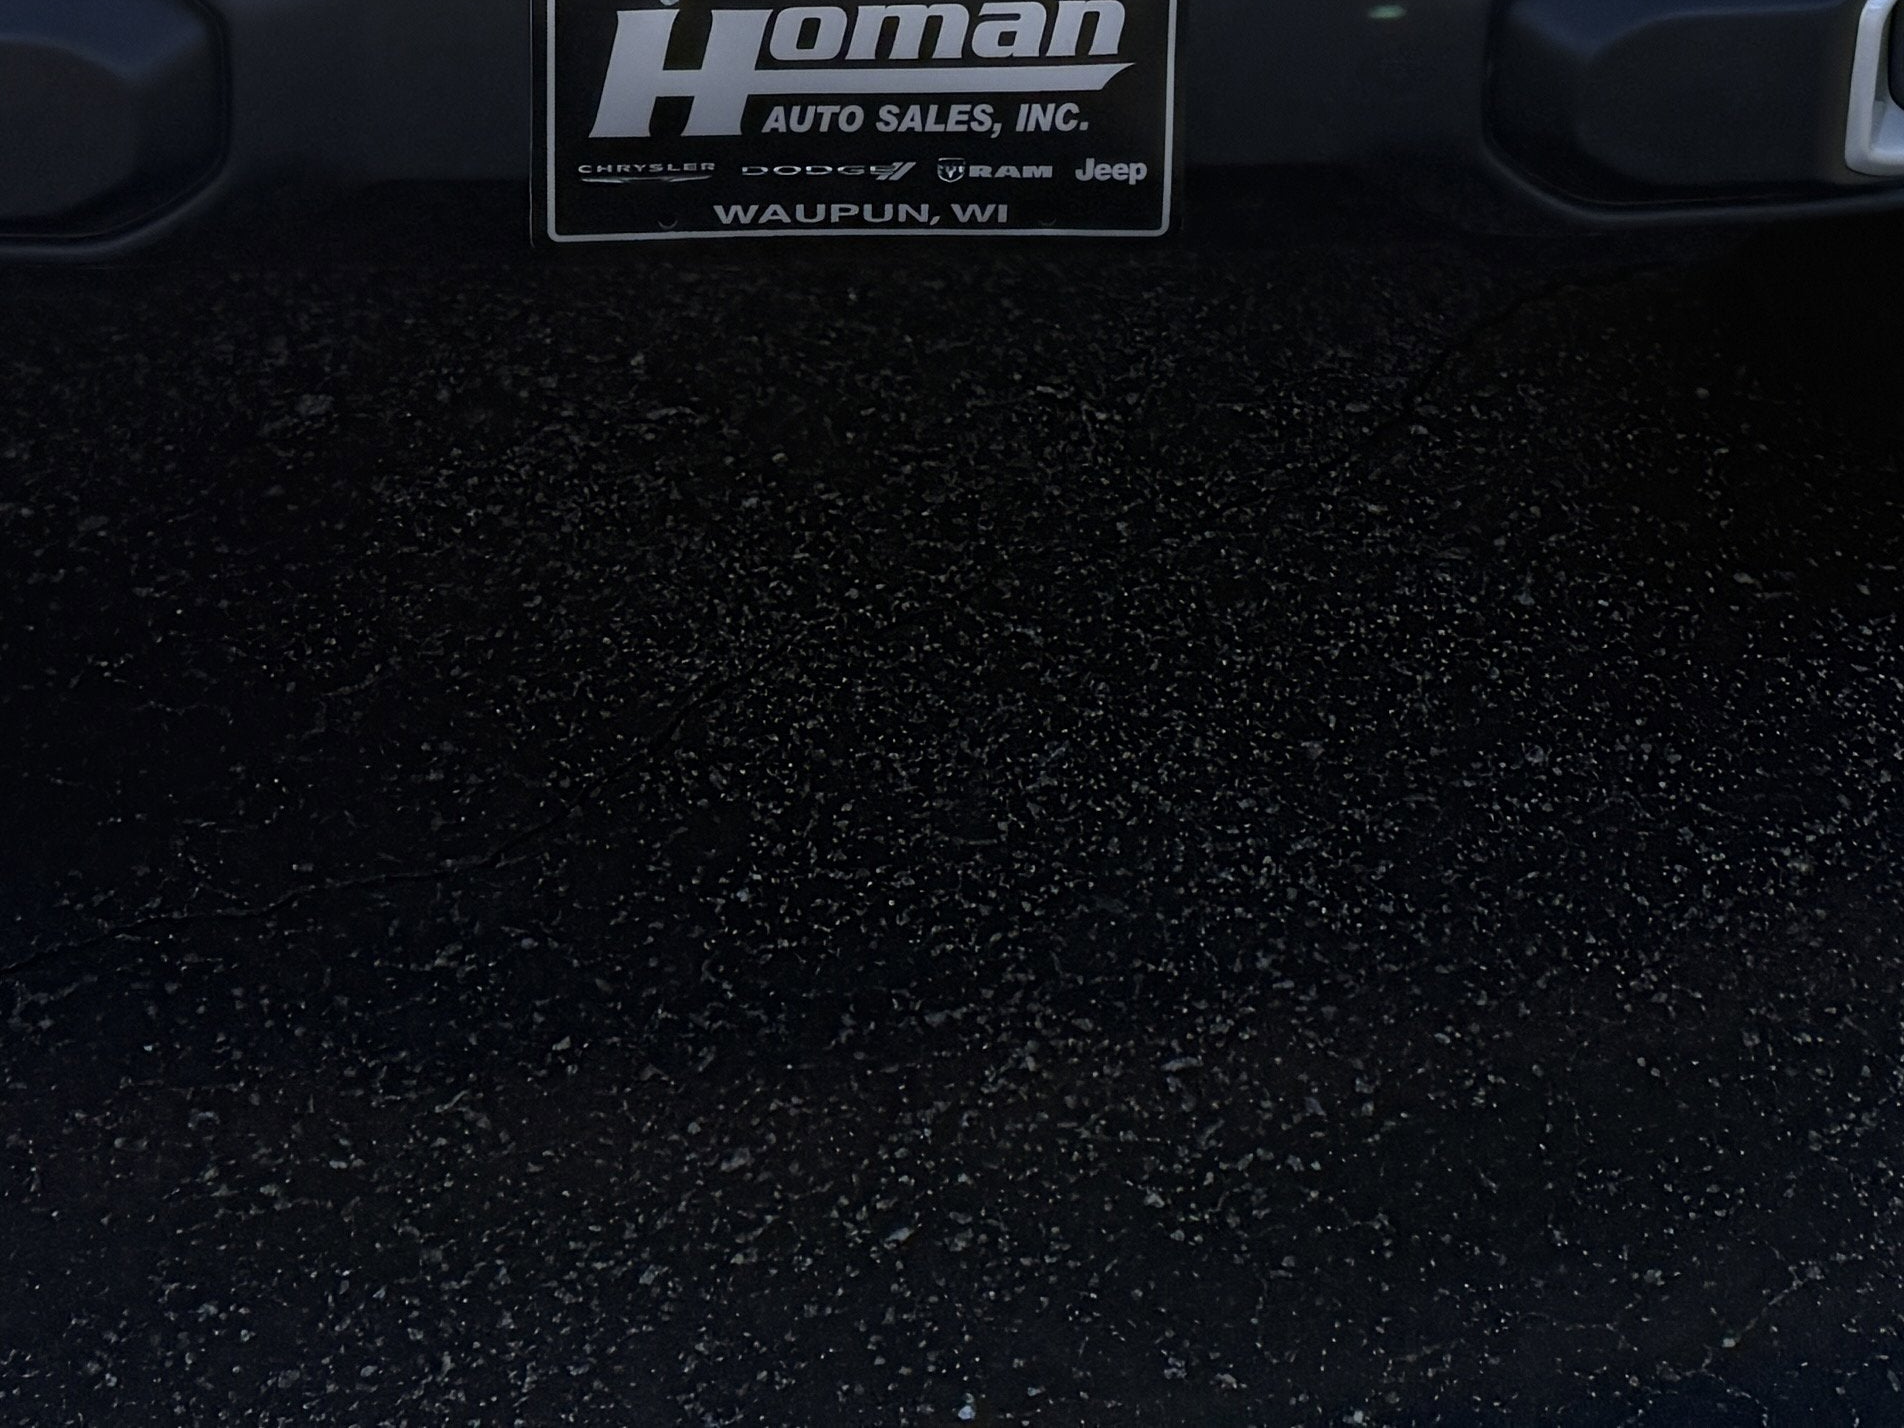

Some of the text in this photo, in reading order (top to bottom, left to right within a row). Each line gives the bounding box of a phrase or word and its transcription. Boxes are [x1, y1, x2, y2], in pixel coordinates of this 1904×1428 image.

[761, 102, 1090, 139] AUTO SALES, INC.
[577, 157, 1148, 186] CHRYSLER DODGE RAM Jeep
[712, 203, 1009, 226] WAUPUN, WI
